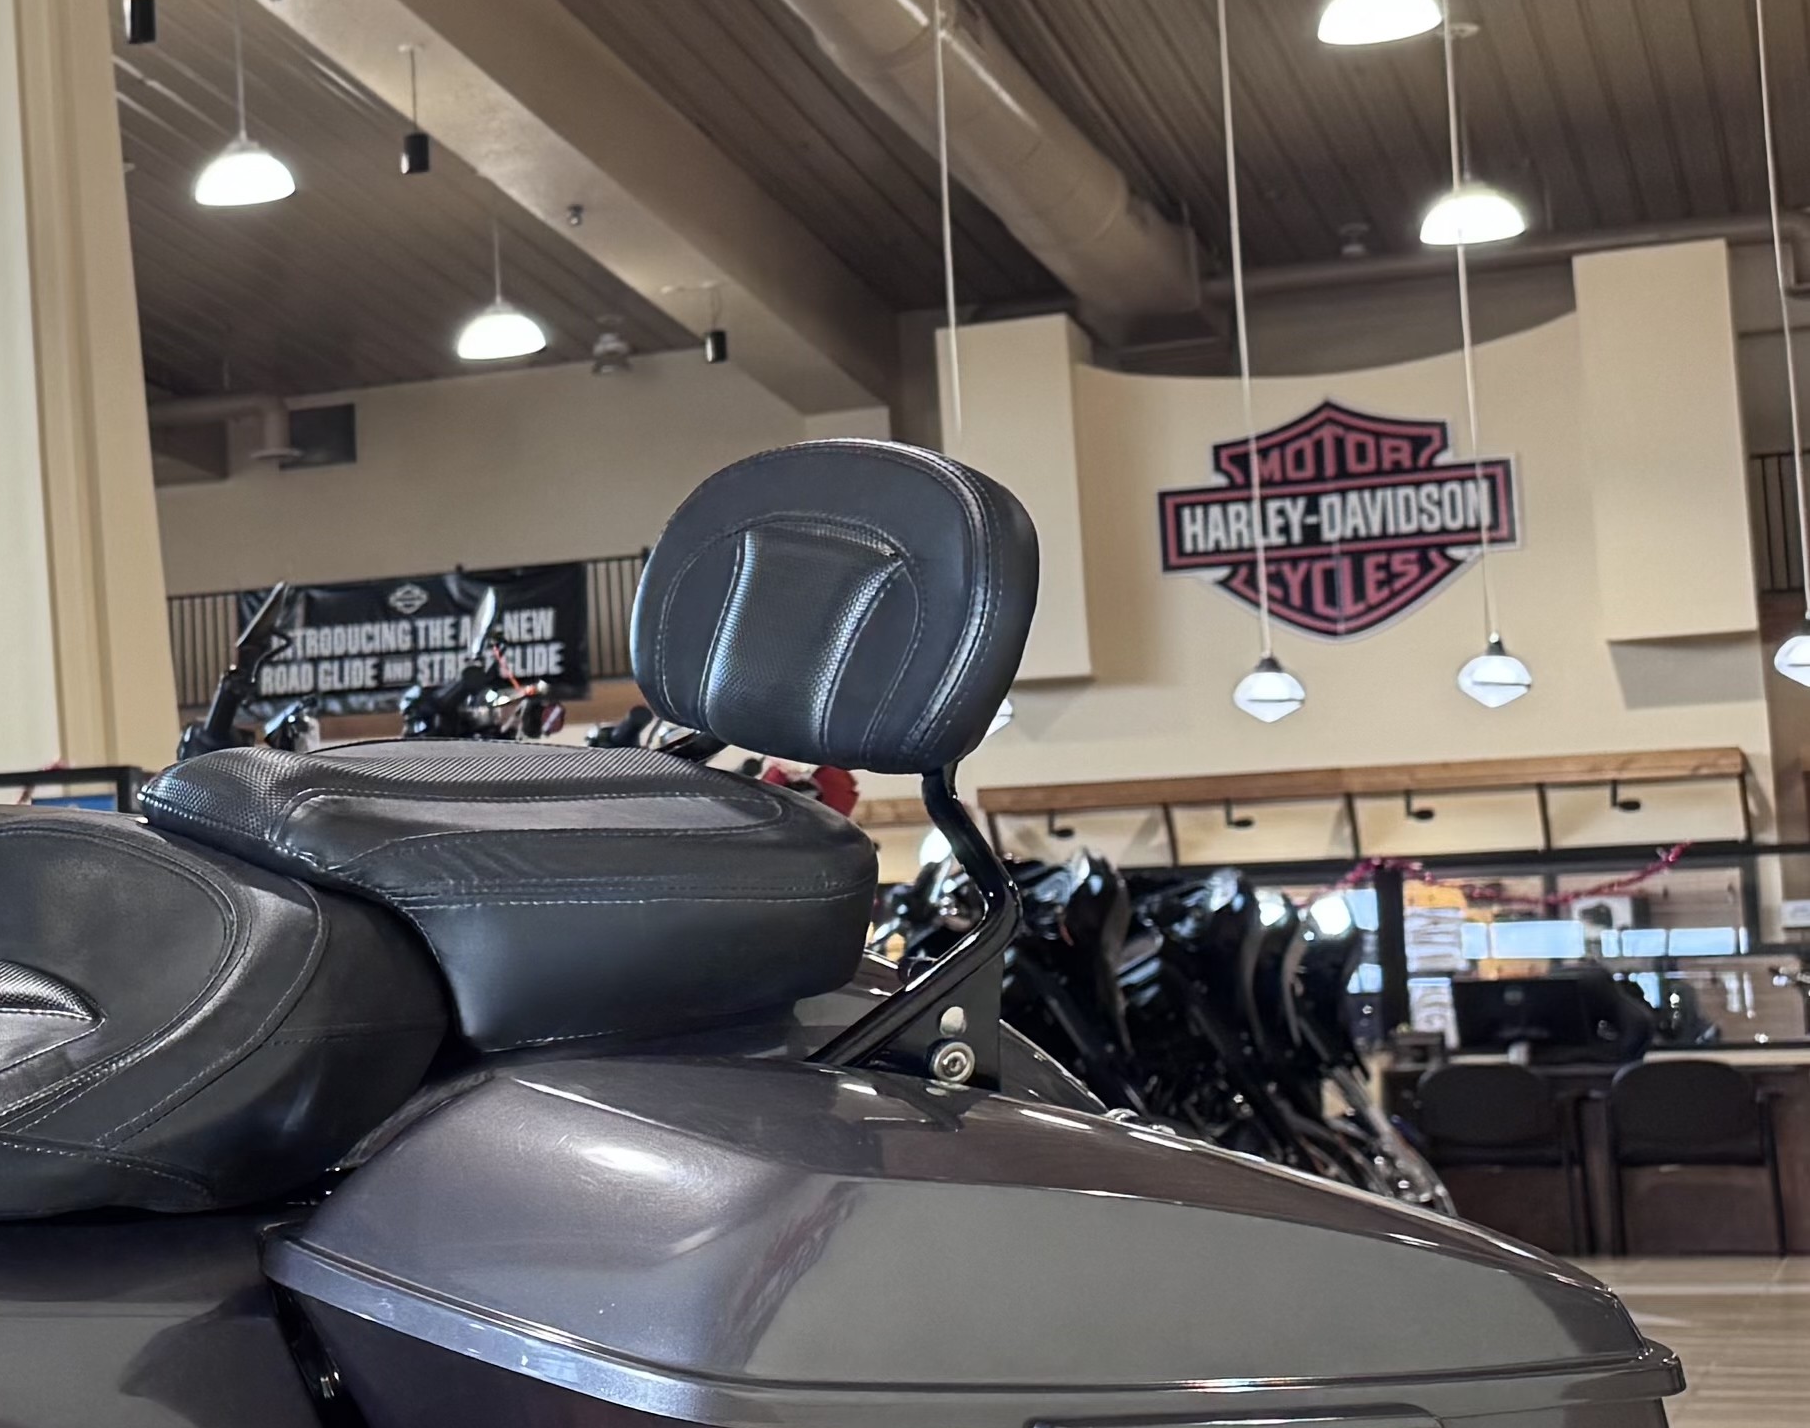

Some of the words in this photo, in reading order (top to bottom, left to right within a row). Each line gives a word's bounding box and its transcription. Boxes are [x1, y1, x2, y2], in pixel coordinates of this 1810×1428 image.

[1252, 424, 1414, 483] MOTOR
[1182, 479, 1490, 554] HARLEY-DAVIDSON
[1261, 550, 1422, 618] CYCLES
[415, 615, 455, 648] THE
[458, 607, 556, 649] A-NEW
[261, 662, 314, 696] ROAD
[317, 658, 378, 692] GLIDE
[384, 660, 413, 683] AND
